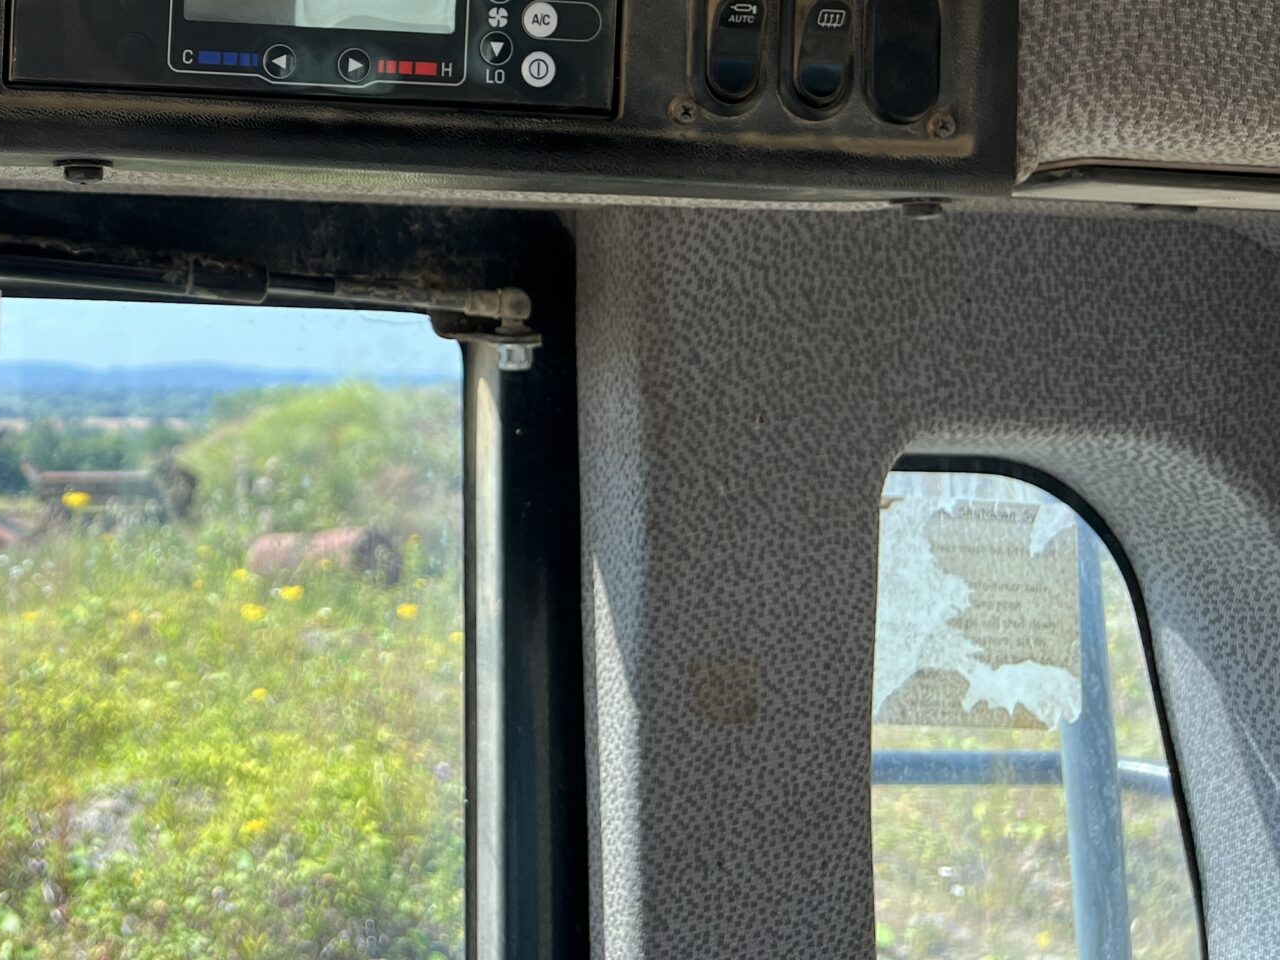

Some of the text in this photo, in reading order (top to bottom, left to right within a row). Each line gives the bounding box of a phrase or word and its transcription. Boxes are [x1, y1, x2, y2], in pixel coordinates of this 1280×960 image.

[531, 12, 551, 26] A/C
[182, 49, 194, 65] C
[441, 62, 453, 78] H
[485, 68, 506, 85] LO
